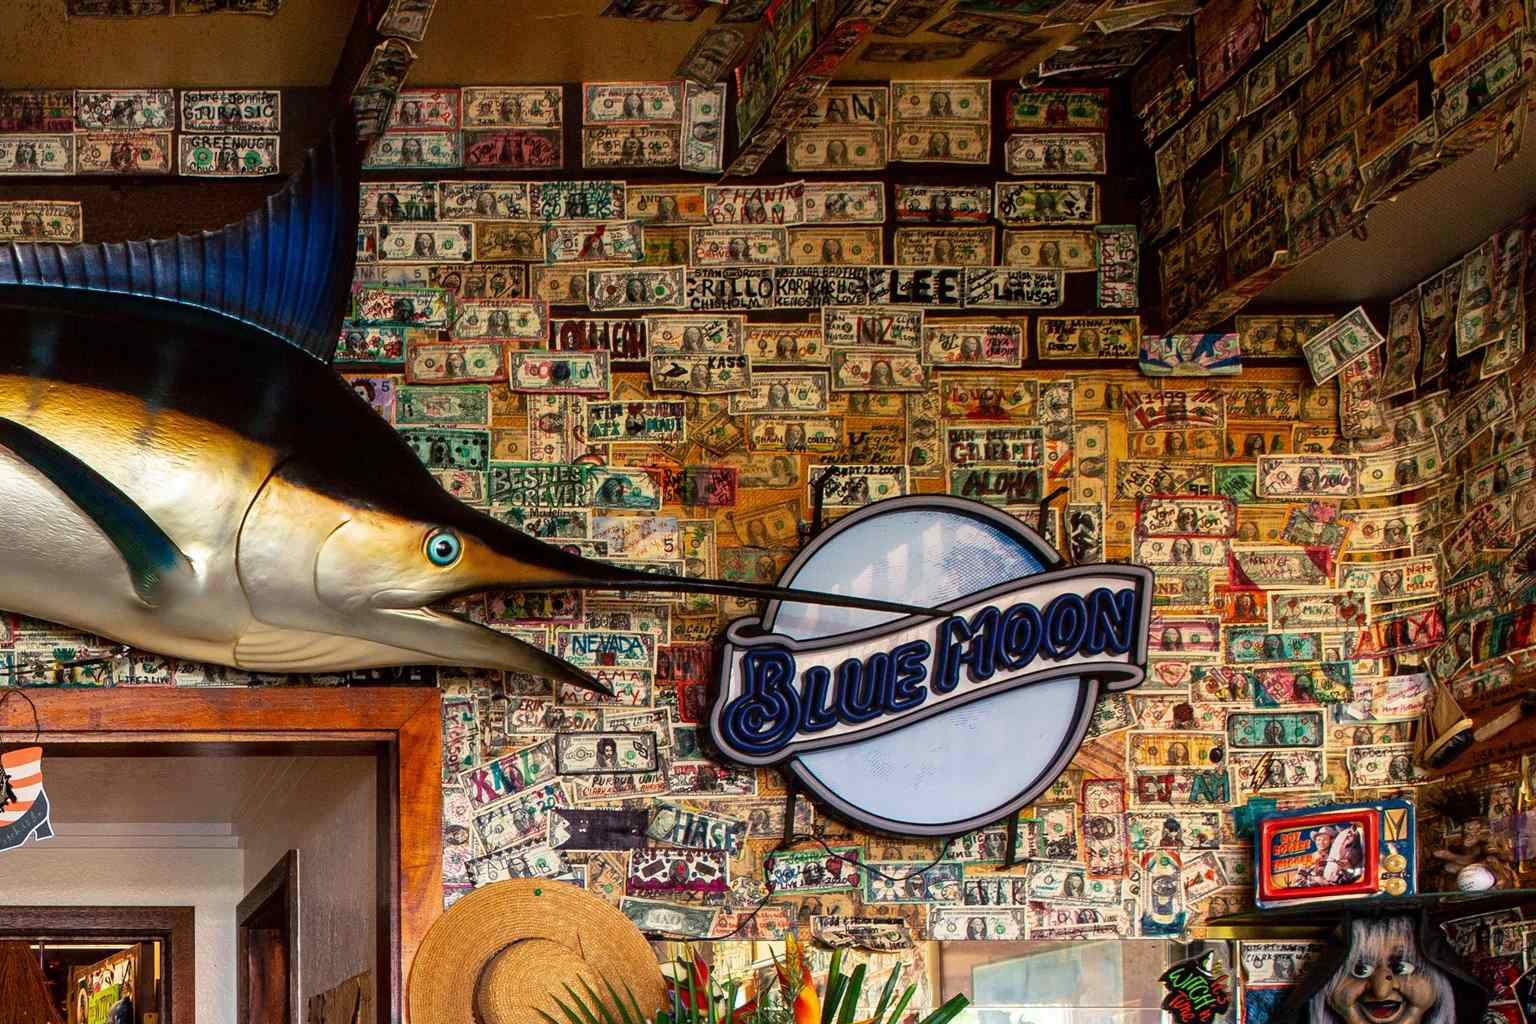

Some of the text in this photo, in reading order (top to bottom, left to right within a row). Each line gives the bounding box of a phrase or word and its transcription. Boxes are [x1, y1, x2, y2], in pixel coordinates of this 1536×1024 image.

[686, 279, 773, 298] GRILLO
[889, 270, 961, 303] LEE
[491, 467, 581, 494] BESTIES
[572, 635, 645, 655] NEVADA
[723, 588, 1138, 751] BLUE MOON
[1169, 968, 1216, 1011] WITCH
